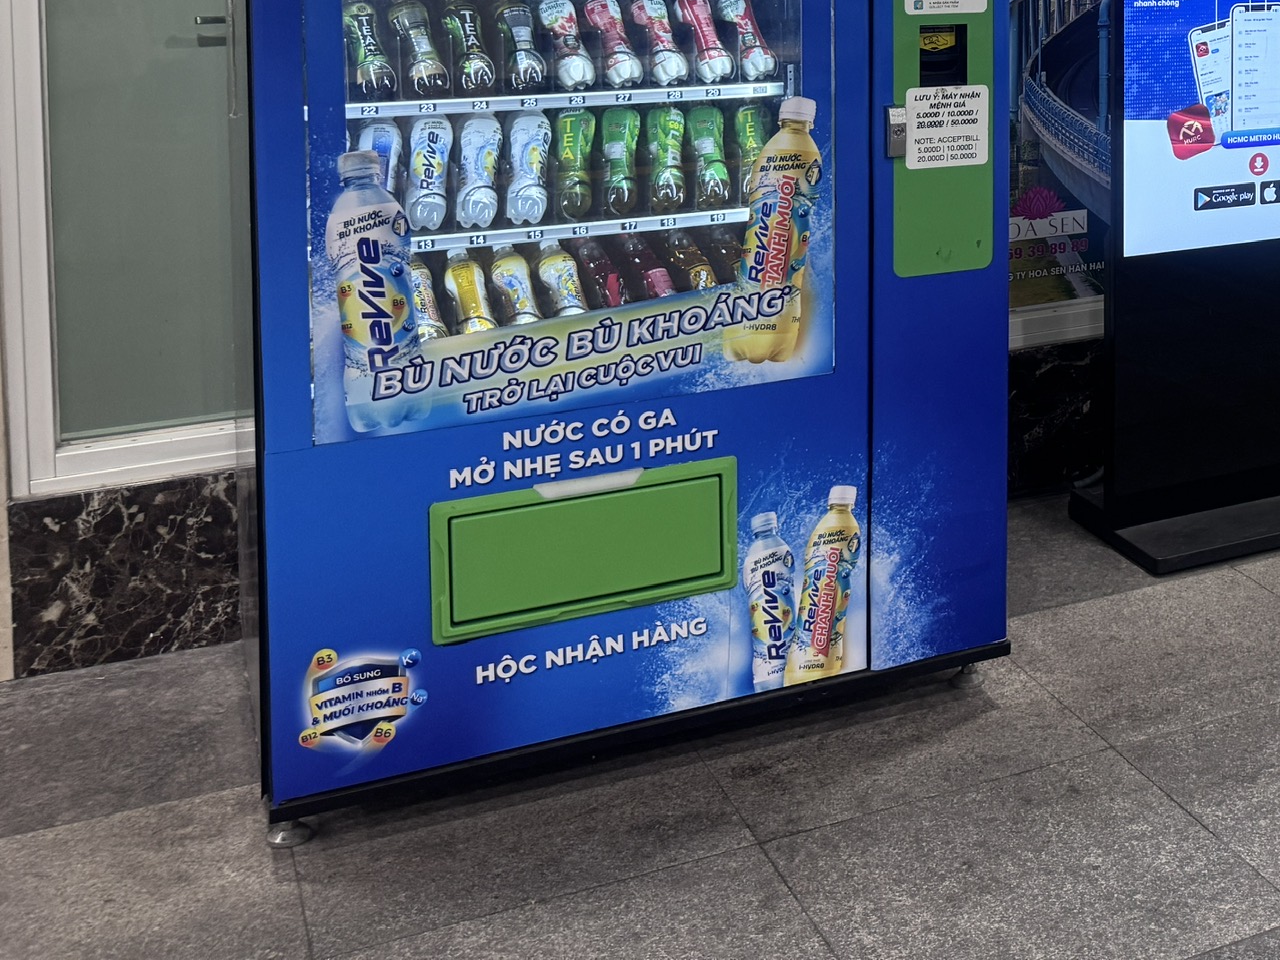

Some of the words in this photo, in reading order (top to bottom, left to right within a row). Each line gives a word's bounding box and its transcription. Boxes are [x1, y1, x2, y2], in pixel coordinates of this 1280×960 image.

[617, 94, 631, 102] 27
[707, 89, 720, 97] 29
[421, 104, 434, 112] 23
[523, 99, 536, 107] 25
[1250, 135, 1272, 143] METRO
[1212, 193, 1238, 203] Google
[1240, 192, 1254, 201] play
[712, 214, 725, 222] 19
[624, 222, 637, 230] 17
[529, 231, 542, 239] 15
[419, 240, 433, 249] 13
[392, 298, 405, 307] B6
[372, 354, 434, 401] BÙ
[440, 336, 558, 387] NƯỚC
[569, 319, 622, 358] BÙ
[464, 384, 527, 414] TRỞ
[530, 372, 575, 402] LẠI
[579, 356, 655, 388] CUỘC
[658, 344, 703, 373] VUI
[503, 420, 583, 450] NƯỚC
[592, 411, 631, 436] CÓ
[638, 408, 677, 430] GA
[450, 456, 496, 488] MỞ
[504, 453, 562, 480] NHẸ
[569, 444, 623, 469] SAU
[631, 442, 641, 460] 1
[650, 428, 719, 457] PHÚT
[813, 590, 835, 650] CHANH
[476, 654, 537, 684] HỘC
[545, 634, 624, 669] NHẬN
[632, 617, 708, 650] HÀNG
[316, 654, 333, 666] B3
[354, 669, 381, 682] SUNG
[315, 690, 364, 711] VITAMIN
[366, 688, 389, 698] NHÓM
[391, 682, 403, 694] B
[312, 717, 320, 727] &
[323, 704, 355, 723] MUỐI
[358, 696, 409, 713] KHOÁNG
[301, 731, 318, 743] B12
[374, 727, 392, 738] B6
